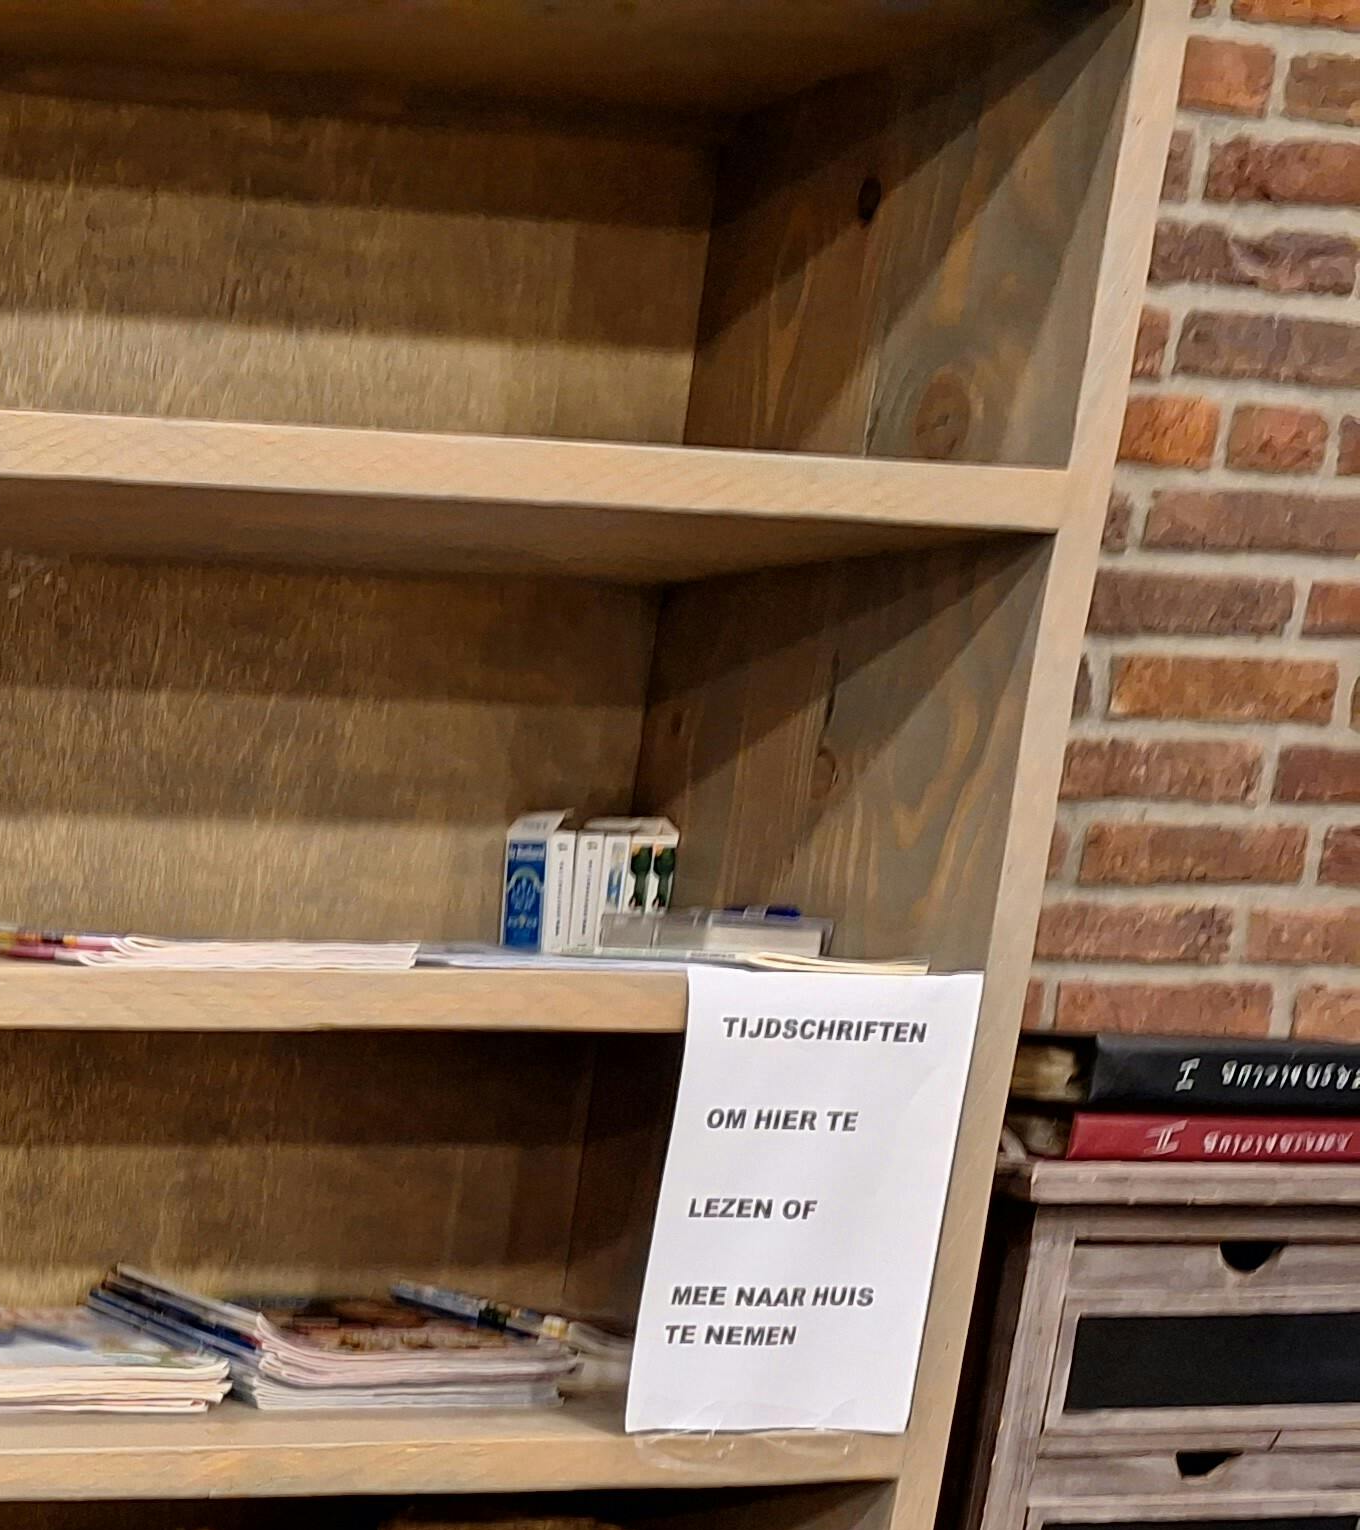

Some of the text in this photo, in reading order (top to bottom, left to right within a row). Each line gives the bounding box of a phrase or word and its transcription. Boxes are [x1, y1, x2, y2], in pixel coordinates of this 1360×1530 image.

[723, 1017, 927, 1043] TIJDSCHRIFTEN
[707, 1109, 858, 1132] OM HIER TE
[688, 1198, 817, 1220] LEZEN OF
[671, 1286, 874, 1307] MEE NAAR HUIS
[665, 1325, 797, 1345] TE NEMEN
